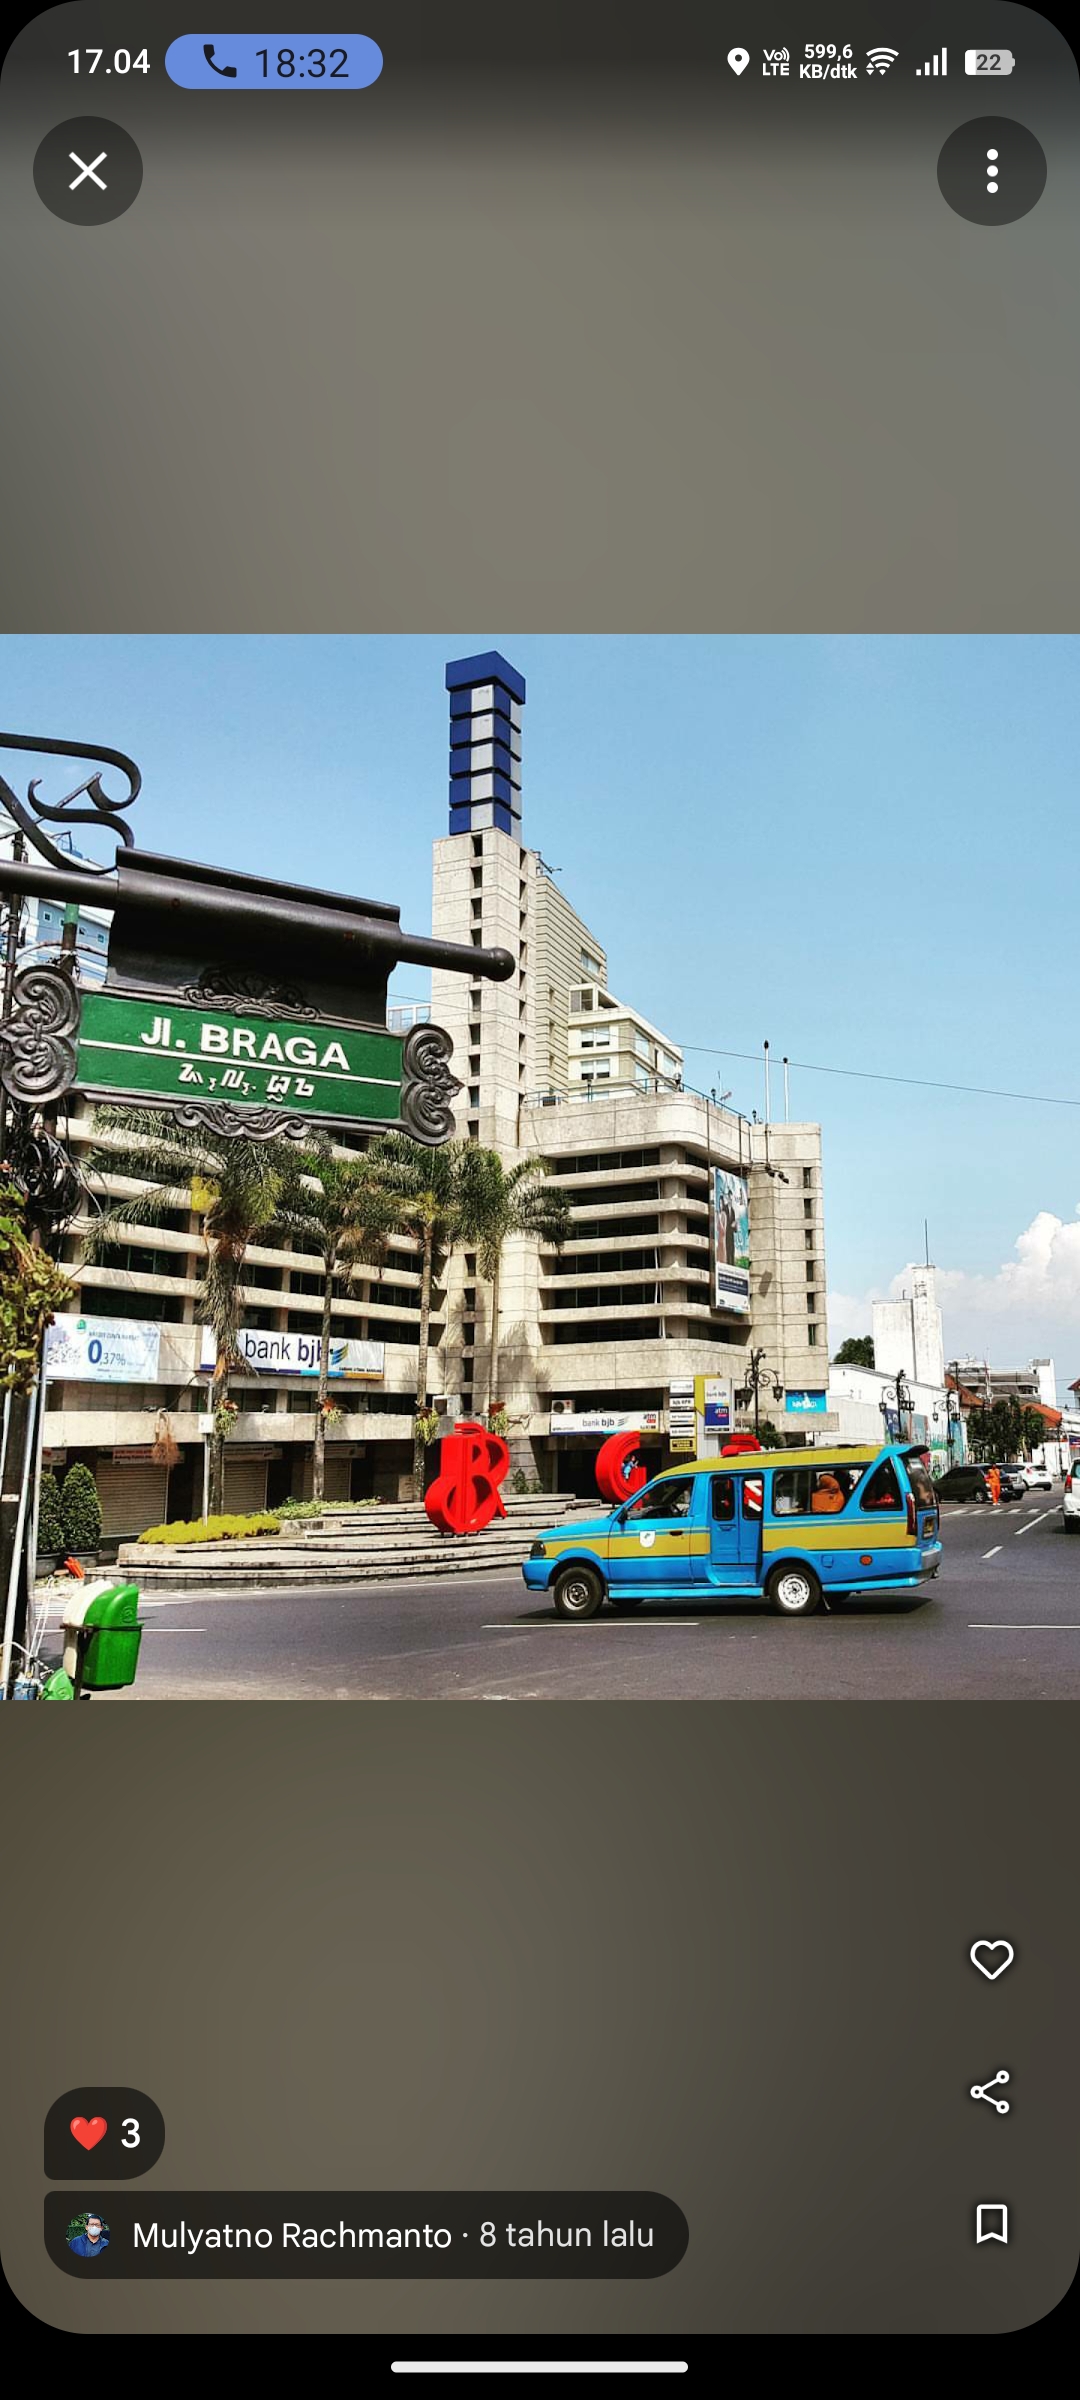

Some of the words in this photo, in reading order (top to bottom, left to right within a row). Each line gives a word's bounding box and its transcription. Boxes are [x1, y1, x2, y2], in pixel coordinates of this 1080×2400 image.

[140, 1016, 186, 1049] Jl.
[200, 1022, 350, 1071] BRAGA
[244, 1332, 291, 1360] bank
[582, 1418, 600, 1428] bank
[601, 1417, 615, 1428] bjb
